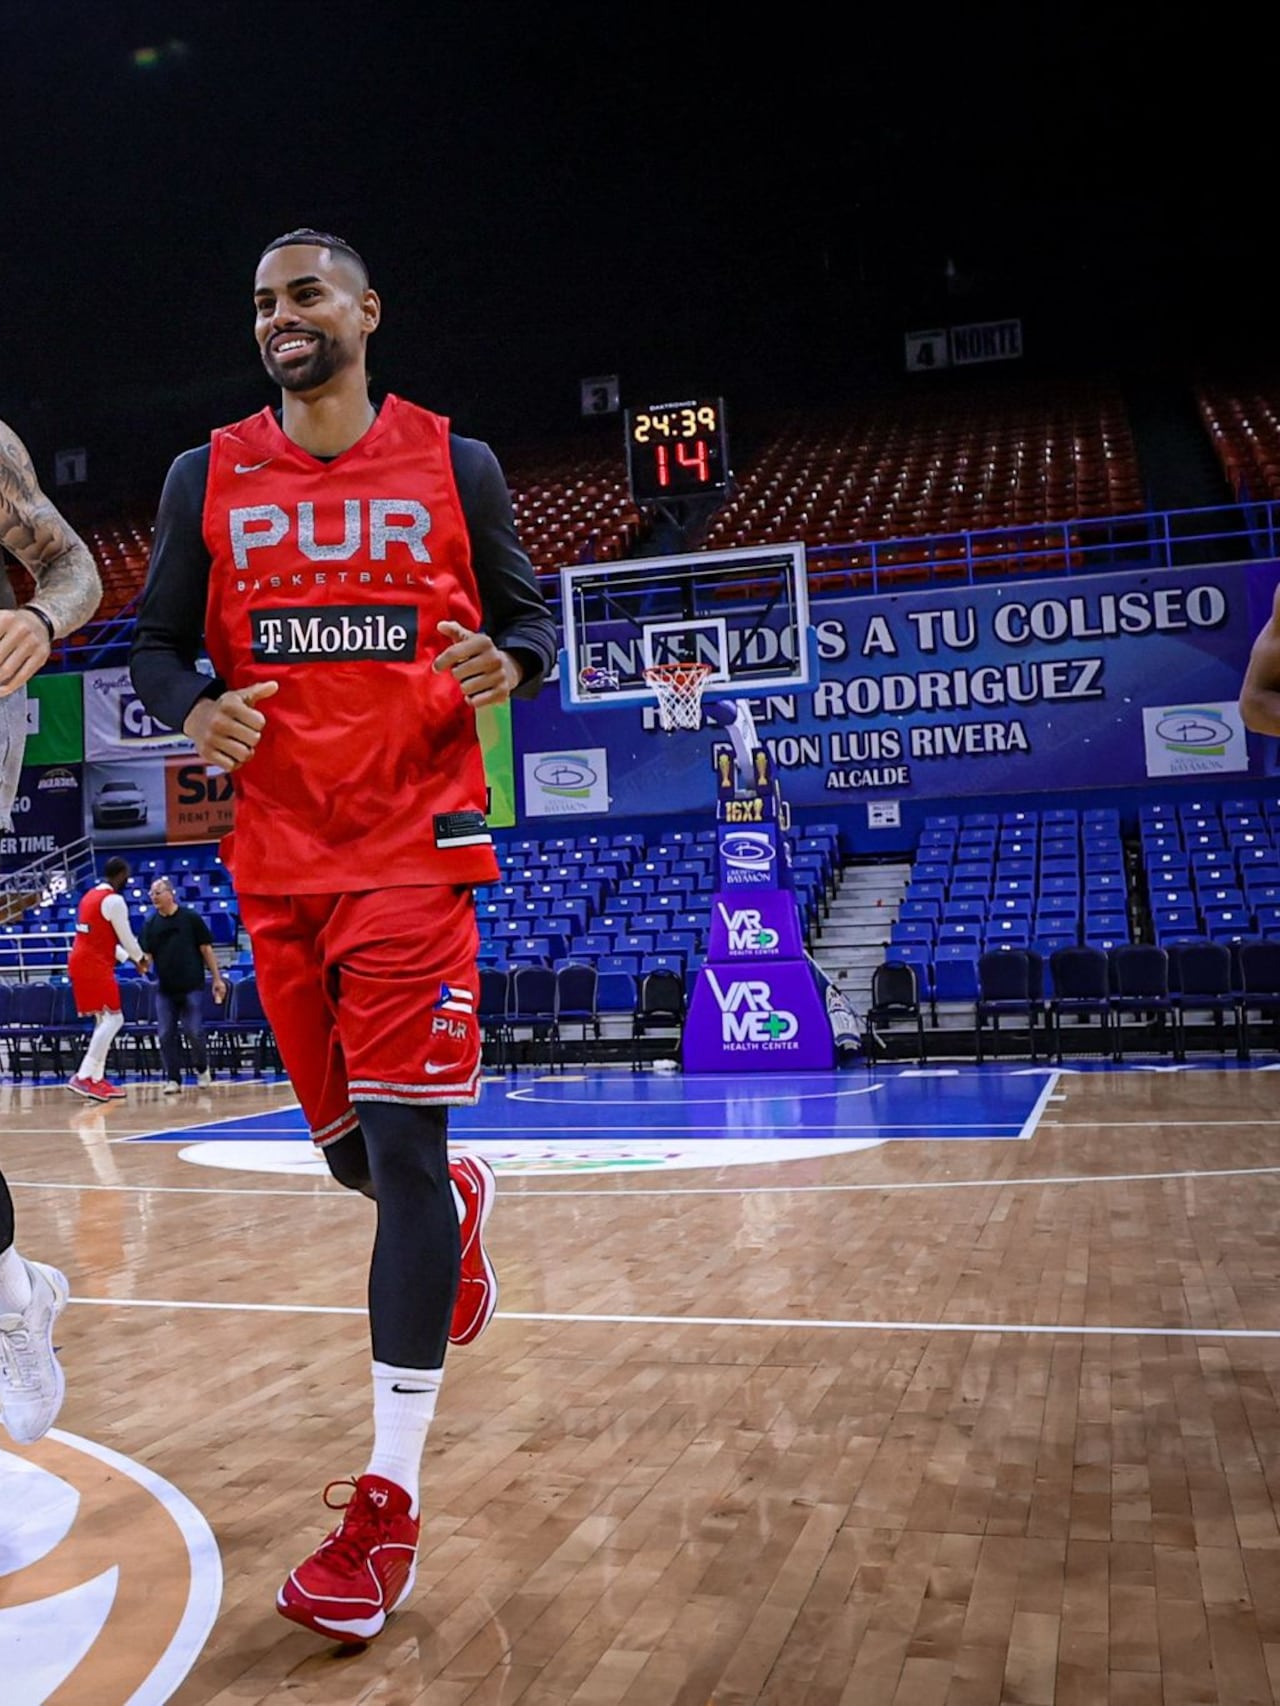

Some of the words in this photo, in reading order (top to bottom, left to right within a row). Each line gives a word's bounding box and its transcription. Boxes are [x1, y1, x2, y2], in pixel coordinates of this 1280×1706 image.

[593, 388, 608, 412] 3
[633, 405, 716, 443] 24:39
[654, 439, 711, 488] 14
[229, 498, 432, 570] PUR
[235, 571, 437, 592] BASKETBALL
[863, 616, 897, 656] A
[908, 607, 976, 650] TU
[994, 585, 1226, 643] COLISEO
[814, 658, 1103, 717] RODRIGUEZ
[830, 729, 900, 763] LUIS
[911, 722, 1029, 757] RIVERA
[826, 766, 910, 789] ALCALDE
[178, 811, 209, 825] RENT
[20, 834, 59, 853] TIME.
[718, 902, 762, 931] VAR
[728, 929, 779, 950] MED
[705, 969, 773, 1012] VAR
[431, 1016, 468, 1040] PUR
[723, 1010, 799, 1042] MED
[723, 1042, 759, 1051] HEALTH
[762, 1041, 800, 1050] CENTER
